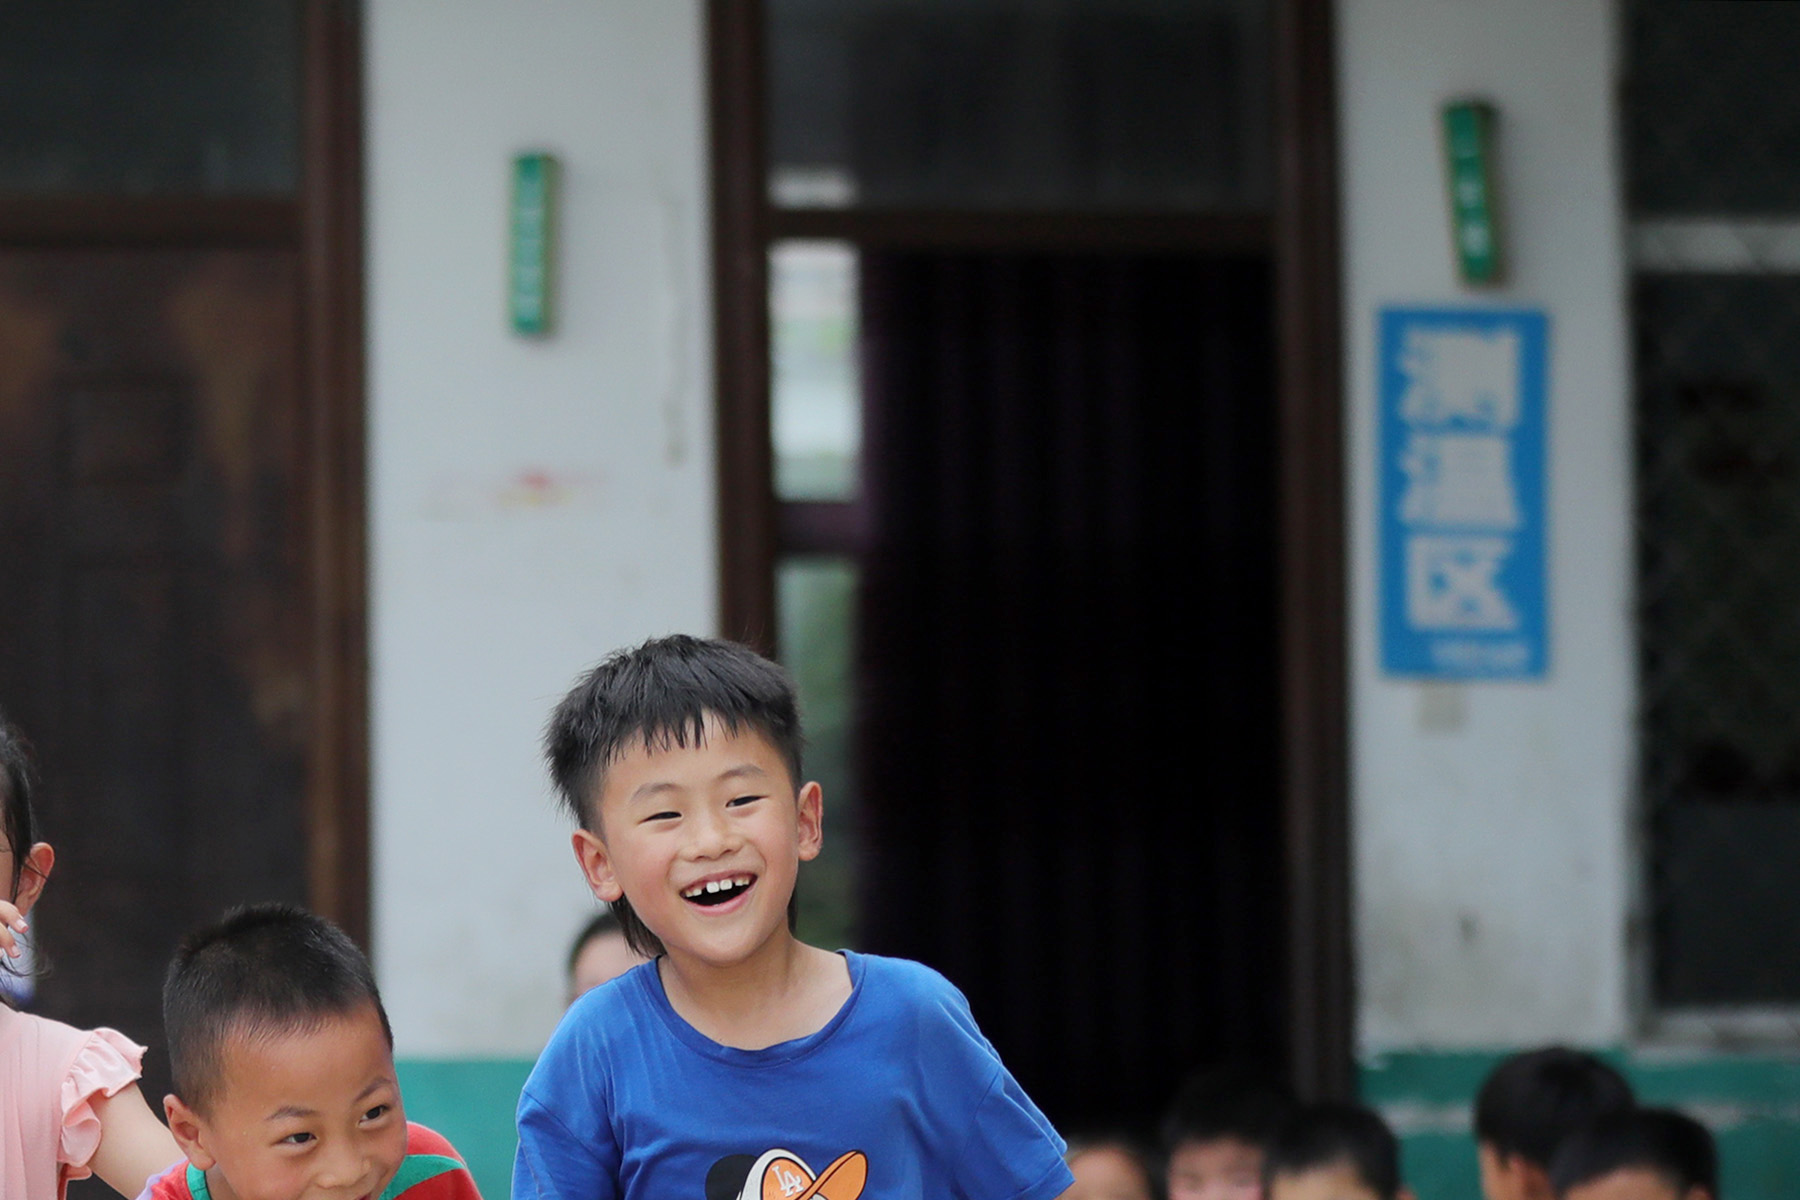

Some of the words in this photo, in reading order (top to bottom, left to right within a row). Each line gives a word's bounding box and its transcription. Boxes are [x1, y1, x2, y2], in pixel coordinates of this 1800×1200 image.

[1398, 325, 1522, 632] 测温区
[771, 1164, 805, 1198] LA
